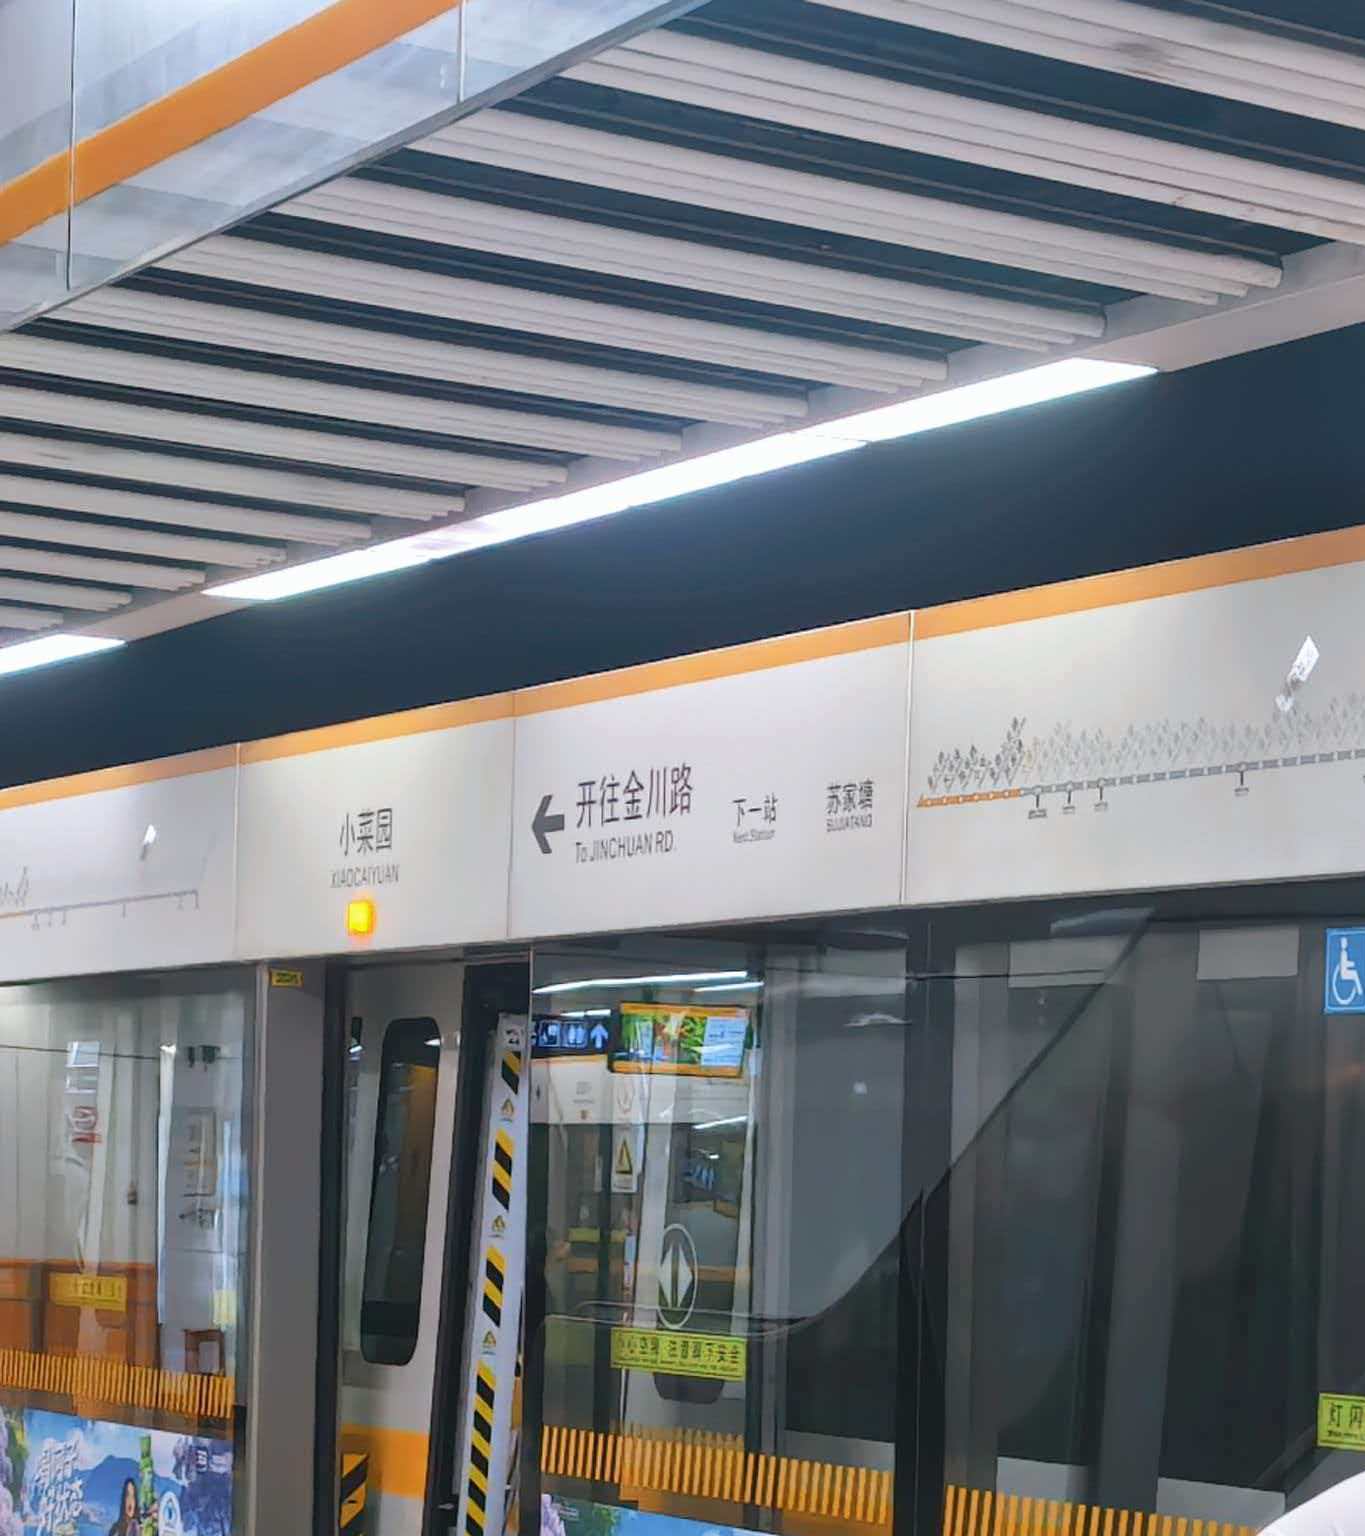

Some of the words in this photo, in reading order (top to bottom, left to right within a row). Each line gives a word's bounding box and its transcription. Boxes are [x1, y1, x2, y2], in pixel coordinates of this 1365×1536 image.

[575, 763, 693, 829] 开往金川路
[732, 792, 778, 826] 下一站
[339, 807, 393, 856] 小菜园
[589, 833, 655, 862] JINCHUAN
